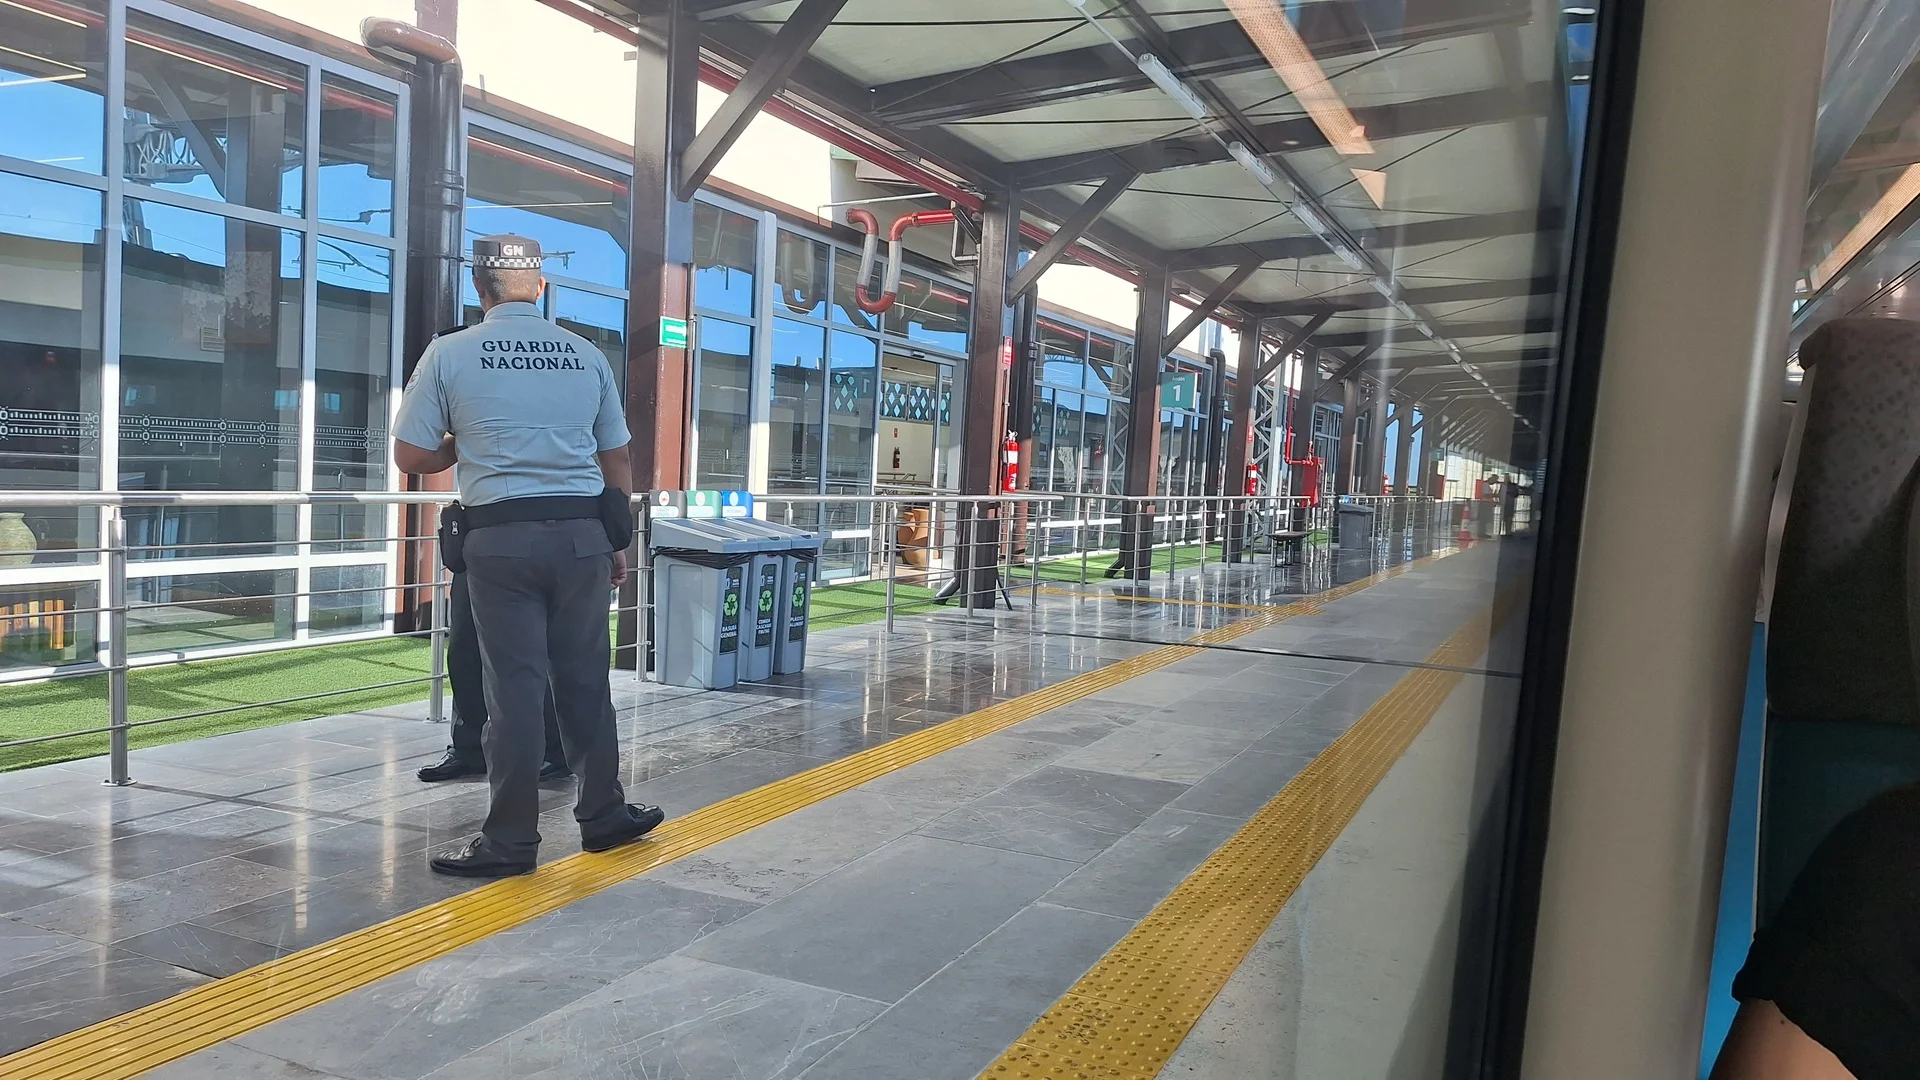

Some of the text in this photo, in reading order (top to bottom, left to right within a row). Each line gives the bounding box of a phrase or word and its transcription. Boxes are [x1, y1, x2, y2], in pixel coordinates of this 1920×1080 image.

[503, 245, 524, 256] GN
[482, 340, 577, 354] GUARDIA
[480, 356, 585, 371] NACIONAL
[1173, 384, 1181, 402] 1
